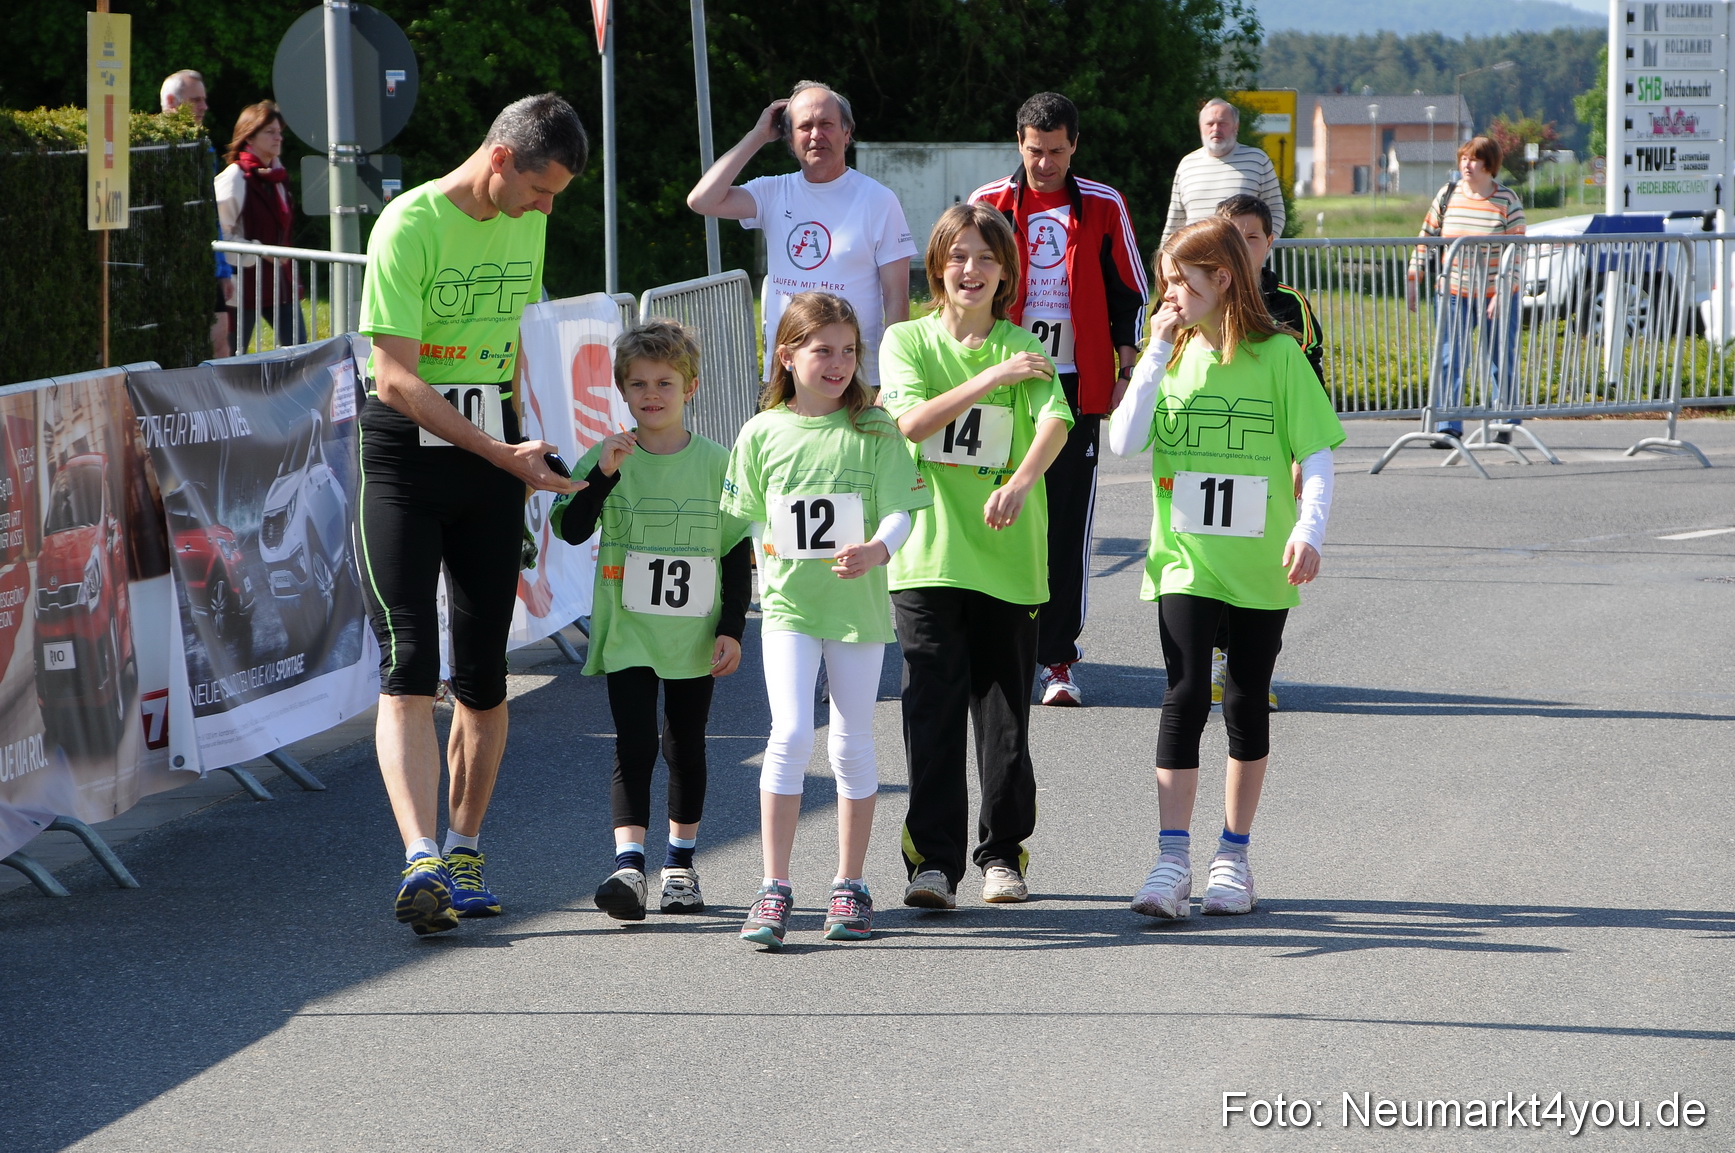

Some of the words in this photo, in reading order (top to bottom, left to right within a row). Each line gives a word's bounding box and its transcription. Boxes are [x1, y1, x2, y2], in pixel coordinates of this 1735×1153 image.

[1638, 76, 1662, 102] SHB
[1636, 146, 1677, 171] THULE
[1041, 278, 1057, 286] MIT
[419, 343, 467, 359] MERZ
[1031, 320, 1062, 357] 21
[942, 407, 982, 457] 14
[1155, 395, 1274, 450] OPF
[1200, 477, 1234, 528] 11
[791, 498, 836, 550] 12
[648, 558, 691, 608] 13
[275, 652, 305, 681] SPORTAGE
